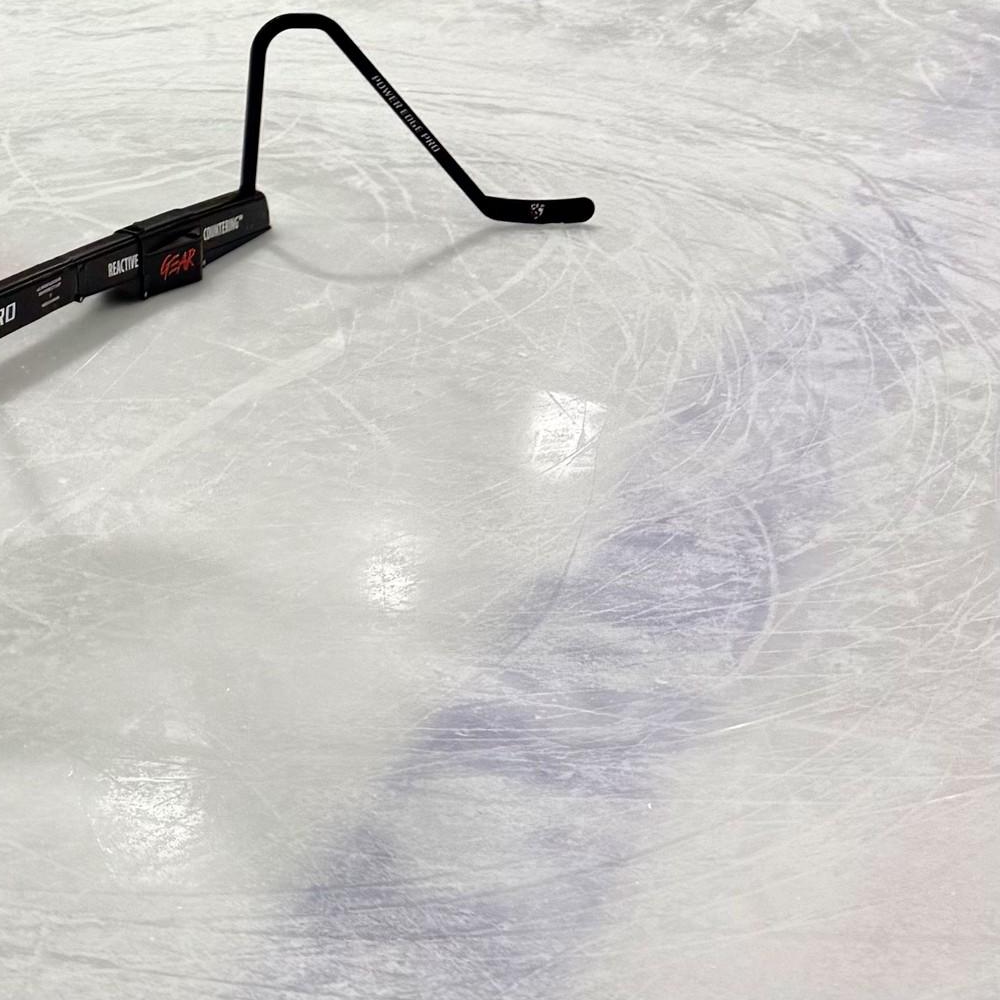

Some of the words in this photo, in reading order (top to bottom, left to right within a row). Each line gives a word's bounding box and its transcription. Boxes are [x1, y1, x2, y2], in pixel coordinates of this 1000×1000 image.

[371, 74, 403, 114] POWER
[400, 106, 424, 133] EDGE
[421, 131, 441, 154] PRO
[107, 254, 139, 277] REACTIVE
[160, 248, 196, 280] GEAR
